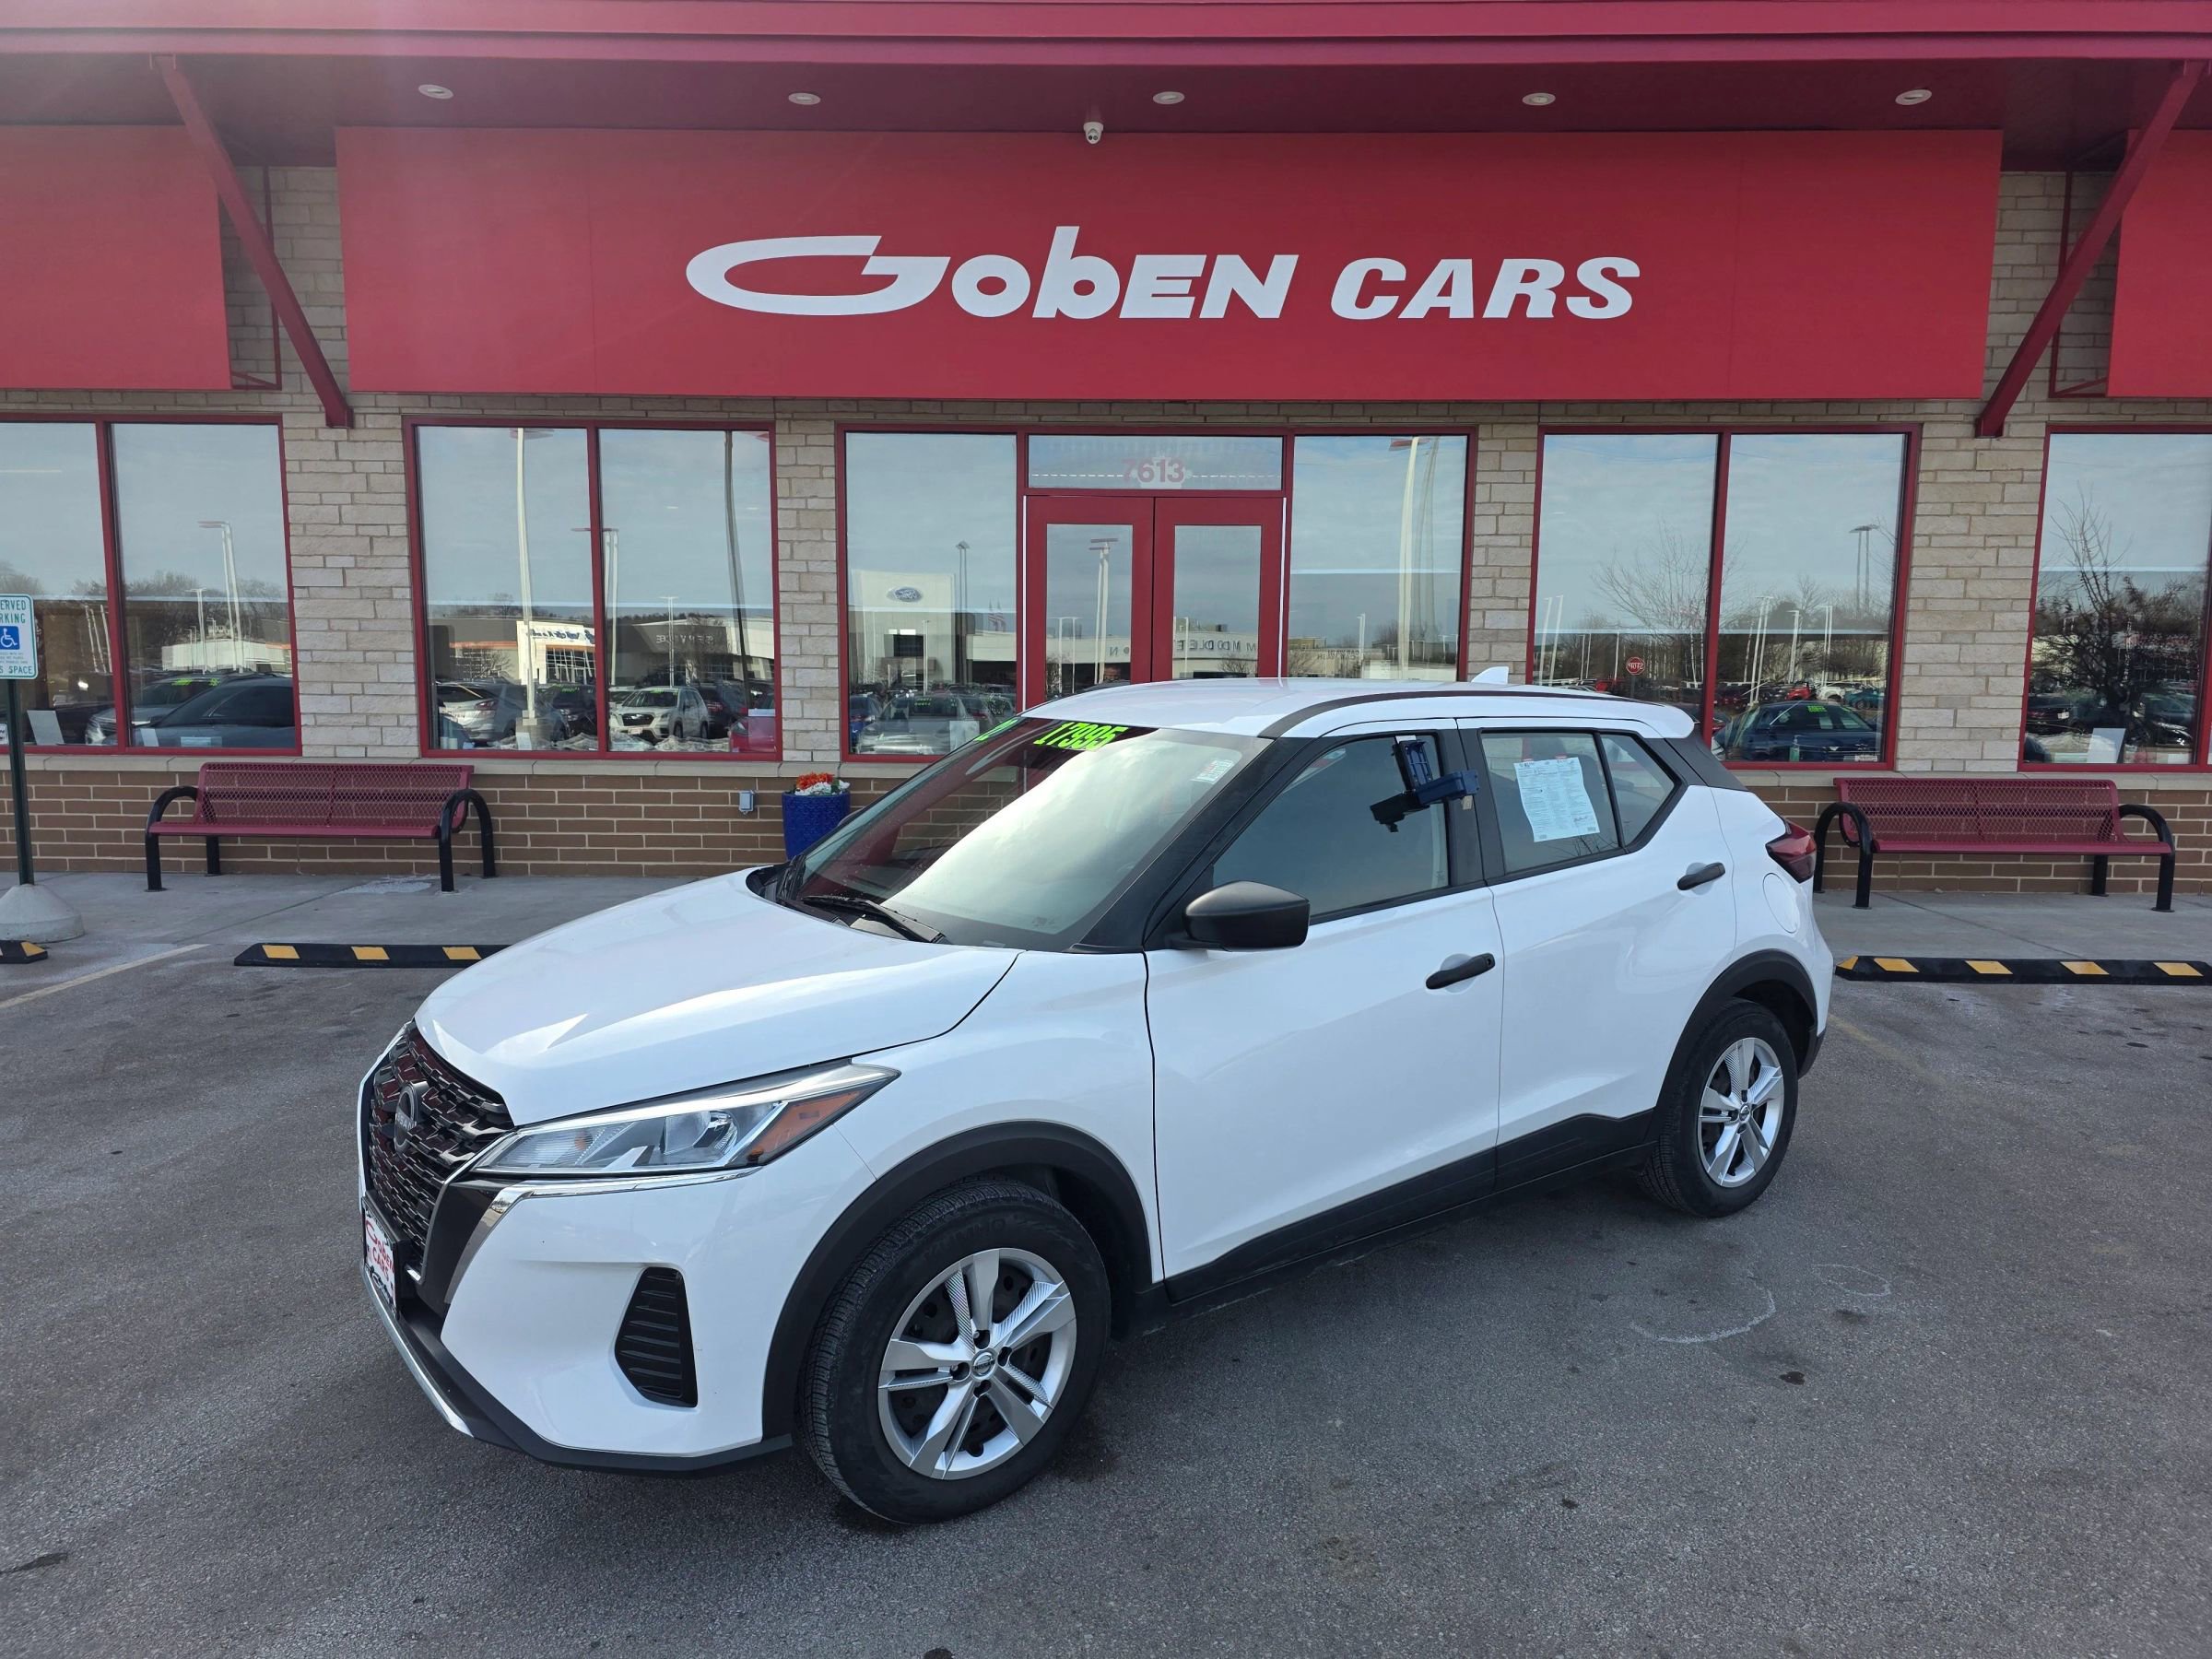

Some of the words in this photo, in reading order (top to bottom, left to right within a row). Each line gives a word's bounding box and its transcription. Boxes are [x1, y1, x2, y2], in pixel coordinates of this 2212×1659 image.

[1329, 256, 1641, 320] CARS
[1121, 457, 1184, 483] 7613
[9, 665, 33, 675] SPACE
[1033, 722, 1129, 752] 17995
